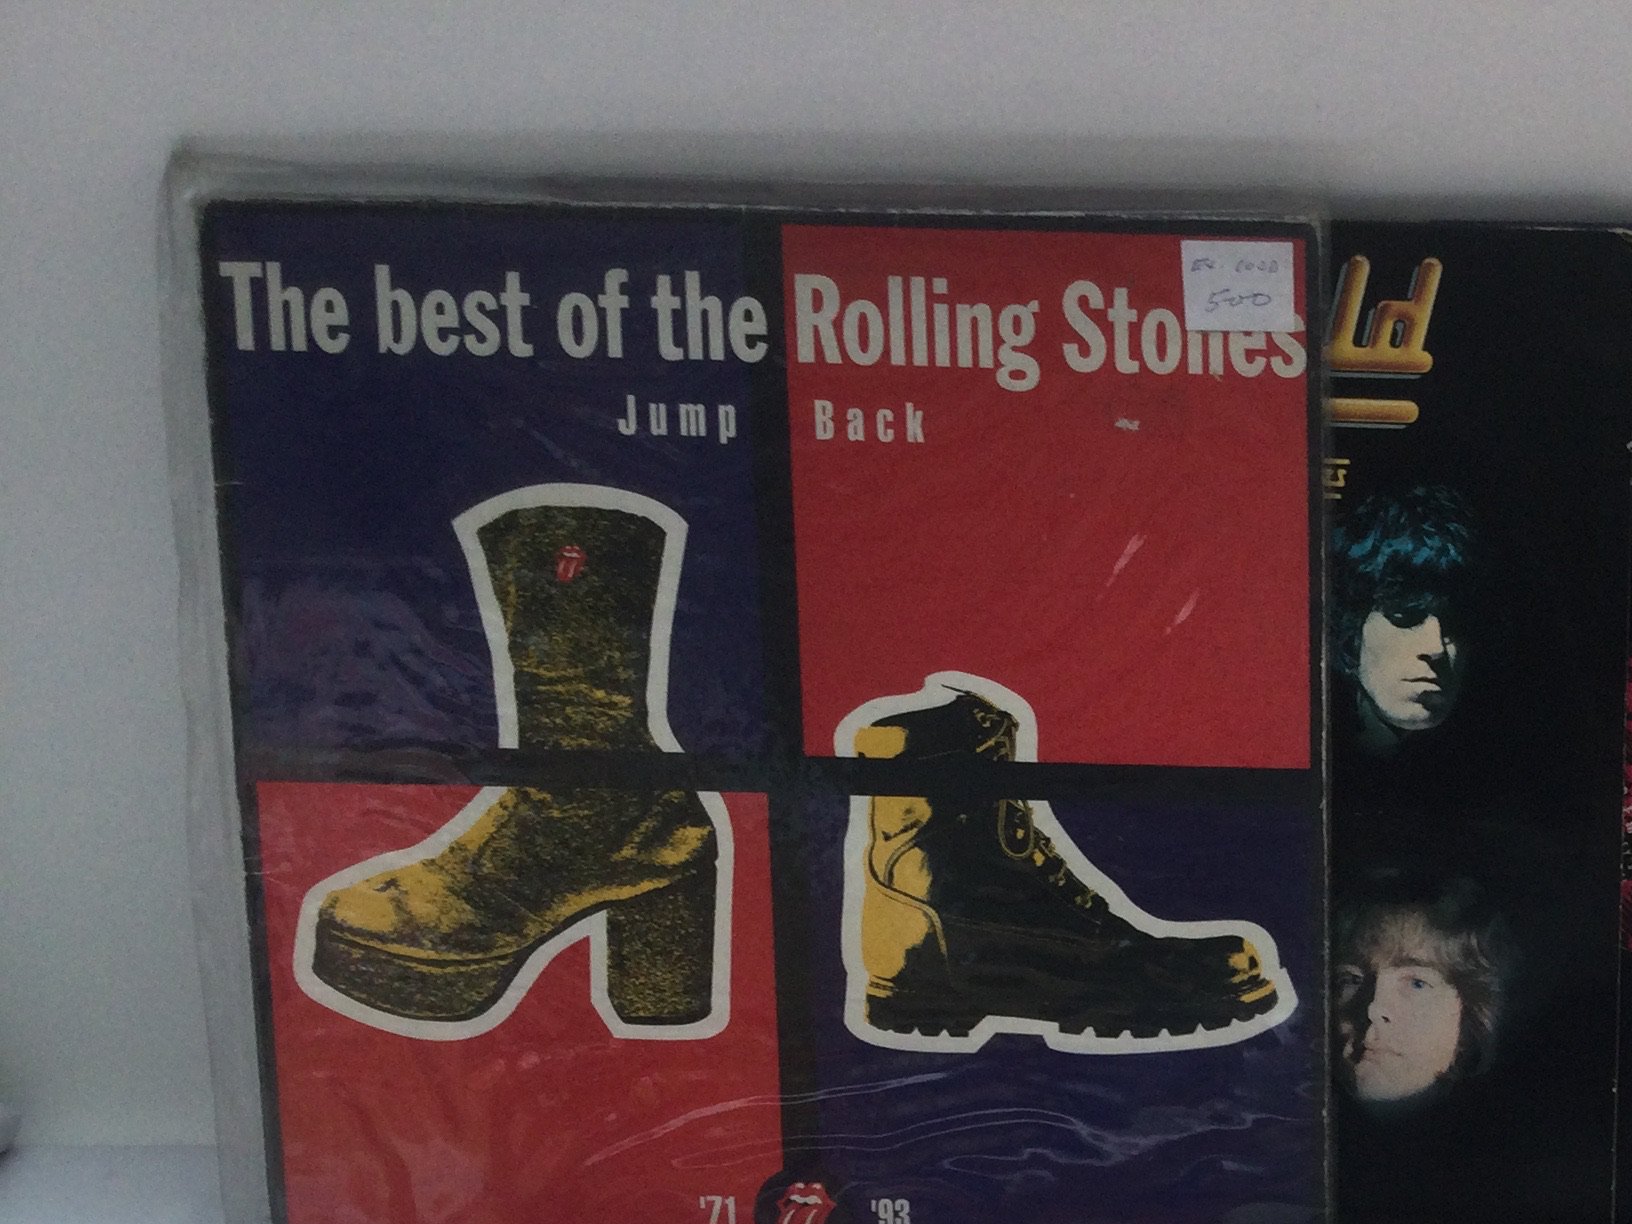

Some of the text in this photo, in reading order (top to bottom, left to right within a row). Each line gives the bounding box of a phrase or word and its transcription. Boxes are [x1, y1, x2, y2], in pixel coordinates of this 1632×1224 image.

[219, 261, 1308, 392] The best of the Rolling Stones
[616, 394, 925, 444] Jump Back
